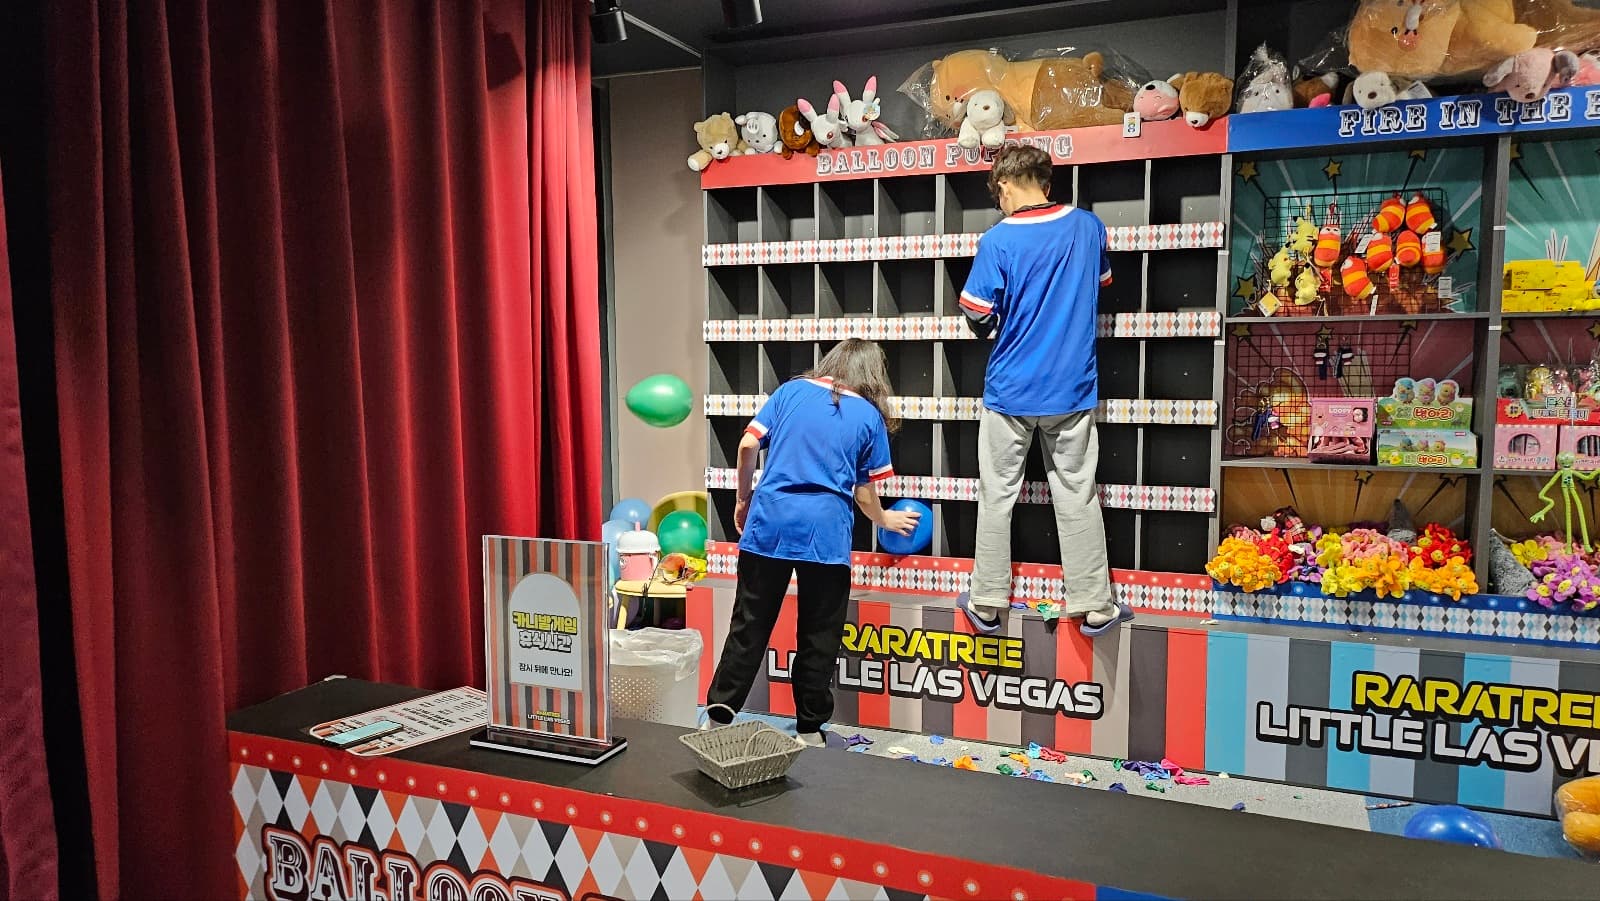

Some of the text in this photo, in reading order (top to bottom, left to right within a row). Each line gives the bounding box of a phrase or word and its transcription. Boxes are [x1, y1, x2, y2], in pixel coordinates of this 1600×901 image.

[1339, 103, 1427, 137] FIRE
[1440, 99, 1482, 131] IN
[1495, 93, 1572, 126] THE
[816, 144, 937, 177] BALLOON
[512, 611, 578, 636] 카니발게임
[519, 630, 572, 653] 휴식시간
[519, 662, 573, 677] 잠시 뒤에 만나요!
[890, 665, 963, 697] LAS
[970, 671, 1102, 714] VEGAS
[1355, 673, 1600, 729] RARATRE
[1259, 704, 1424, 753] LITTLE
[1434, 723, 1538, 765] LAS
